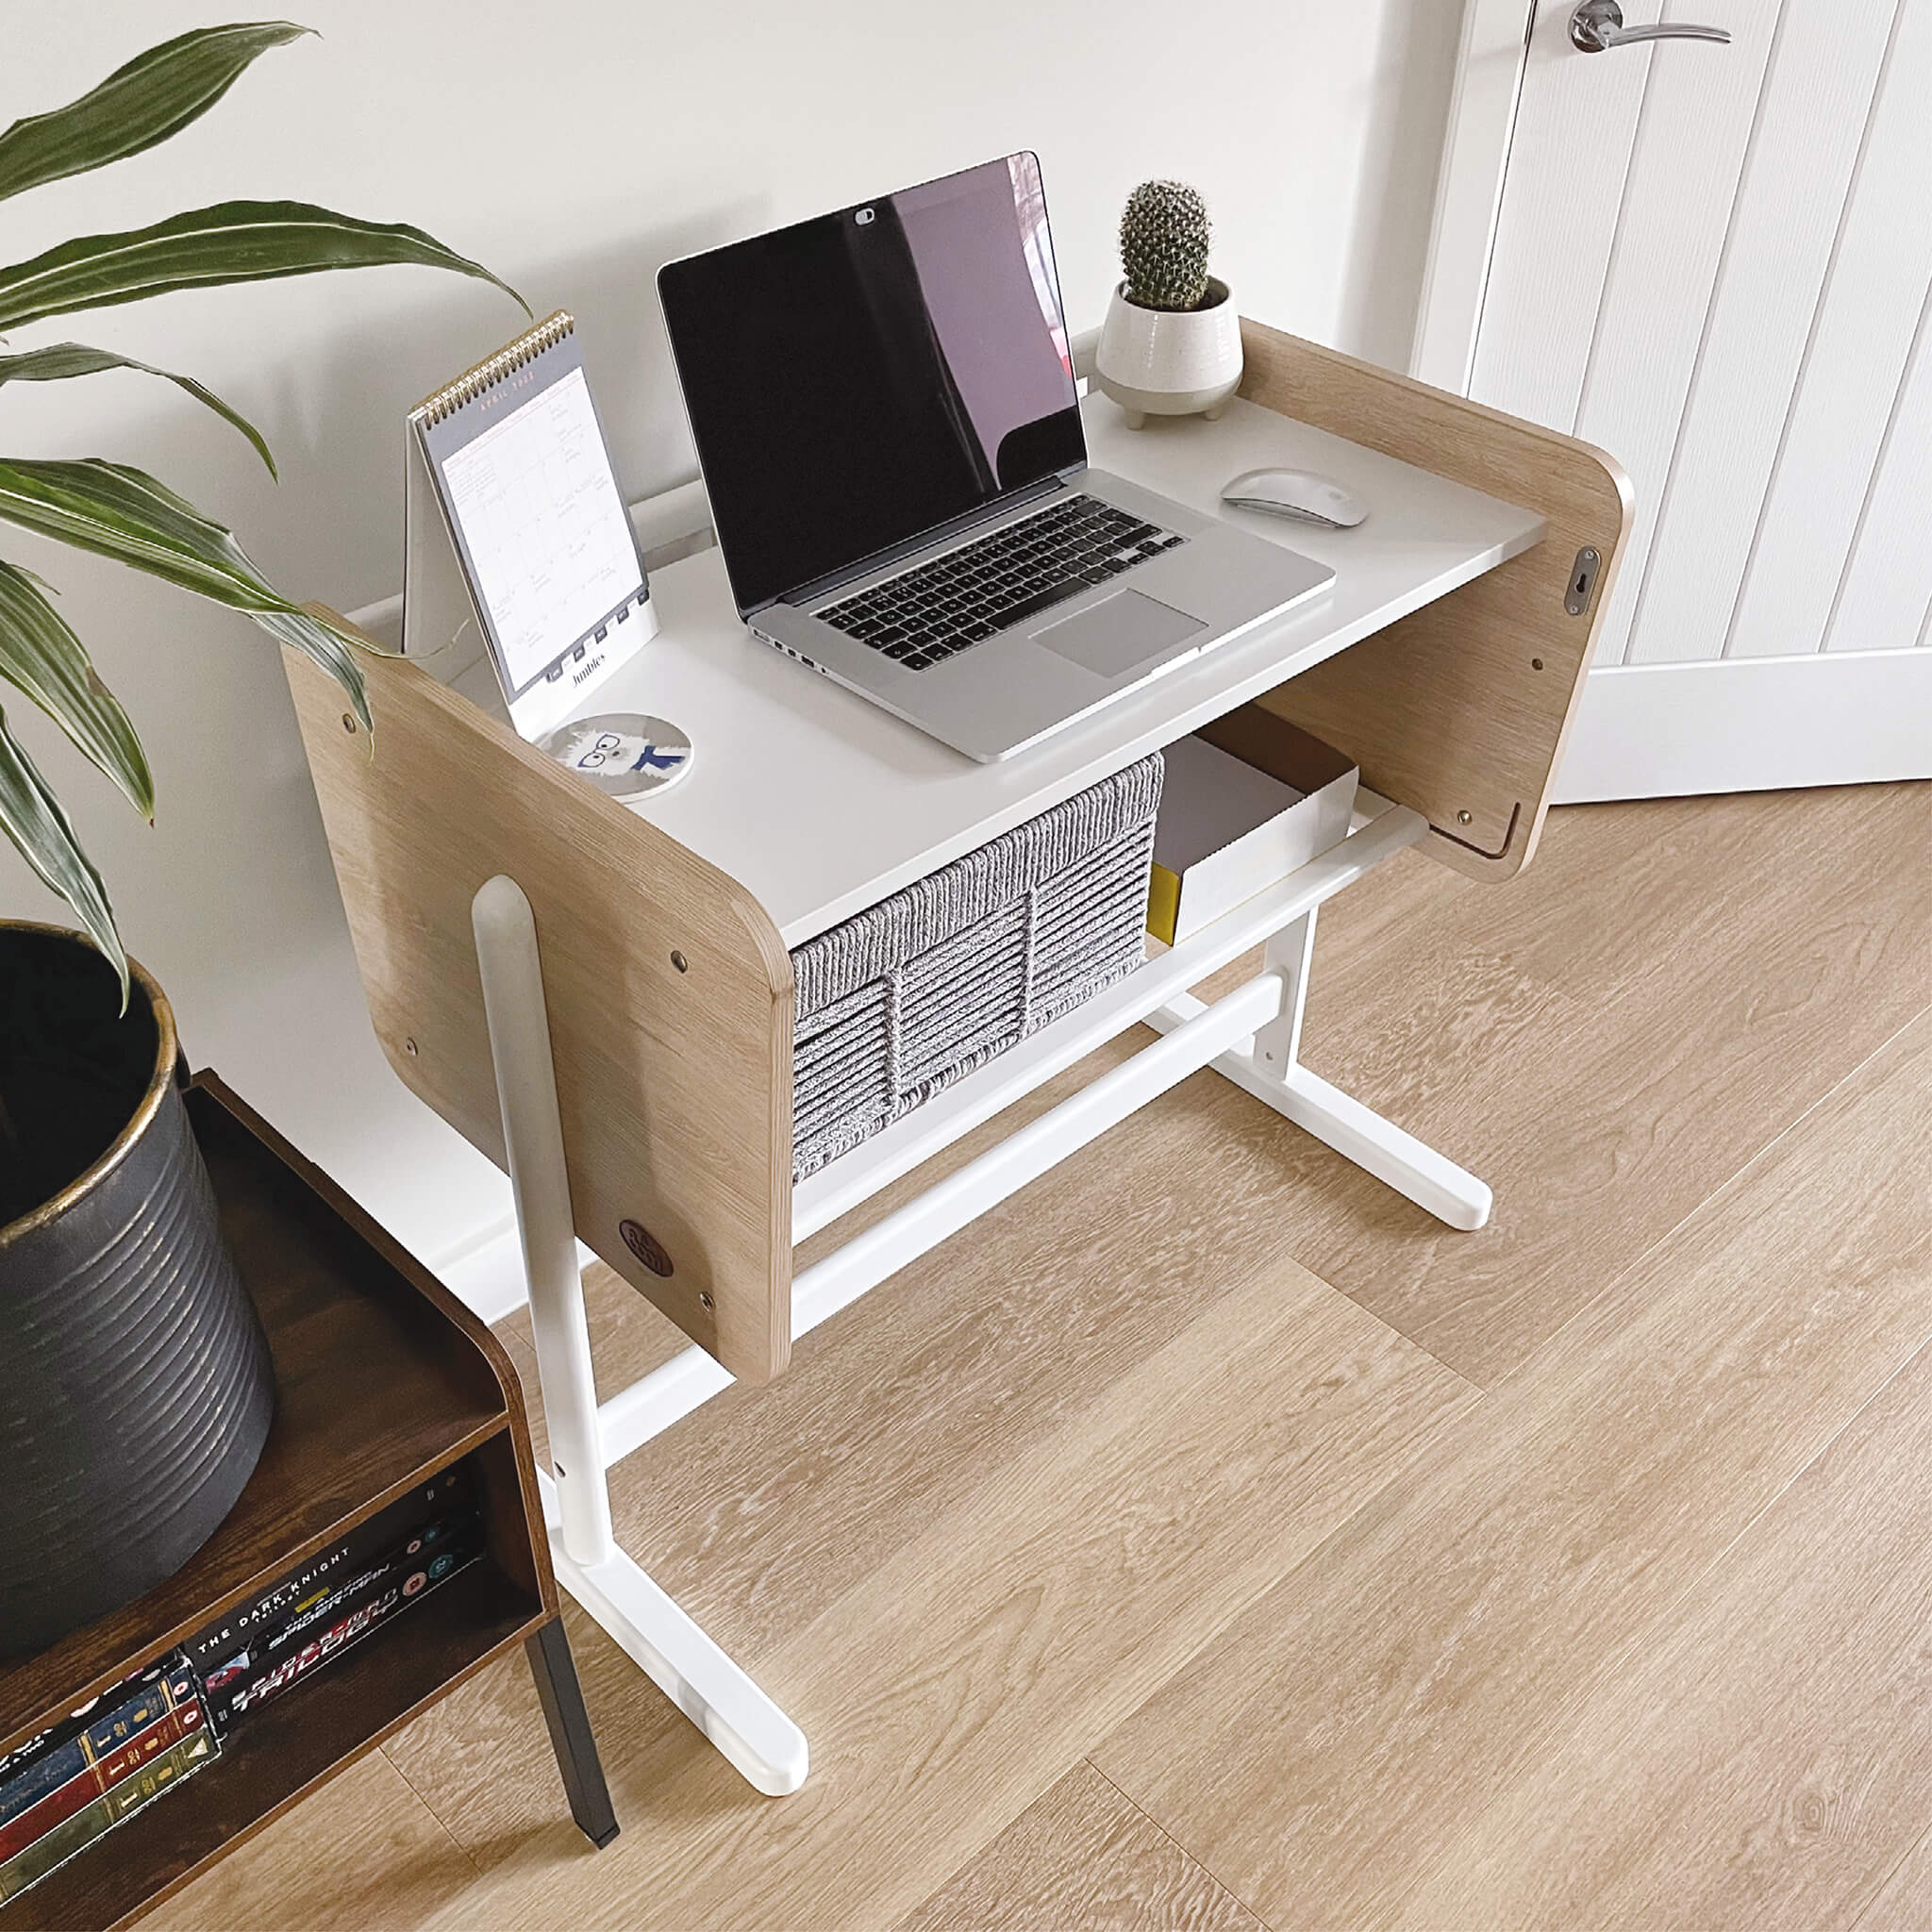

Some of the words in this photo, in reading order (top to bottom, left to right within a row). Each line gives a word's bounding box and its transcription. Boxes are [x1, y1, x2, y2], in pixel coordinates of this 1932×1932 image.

[197, 1628, 231, 1654] THE
[239, 1594, 282, 1627] DARK
[291, 1547, 350, 1592] KNIGHT
[233, 1592, 399, 1712] TRILOGY
[268, 1563, 391, 1651] SPIDER-MAN
